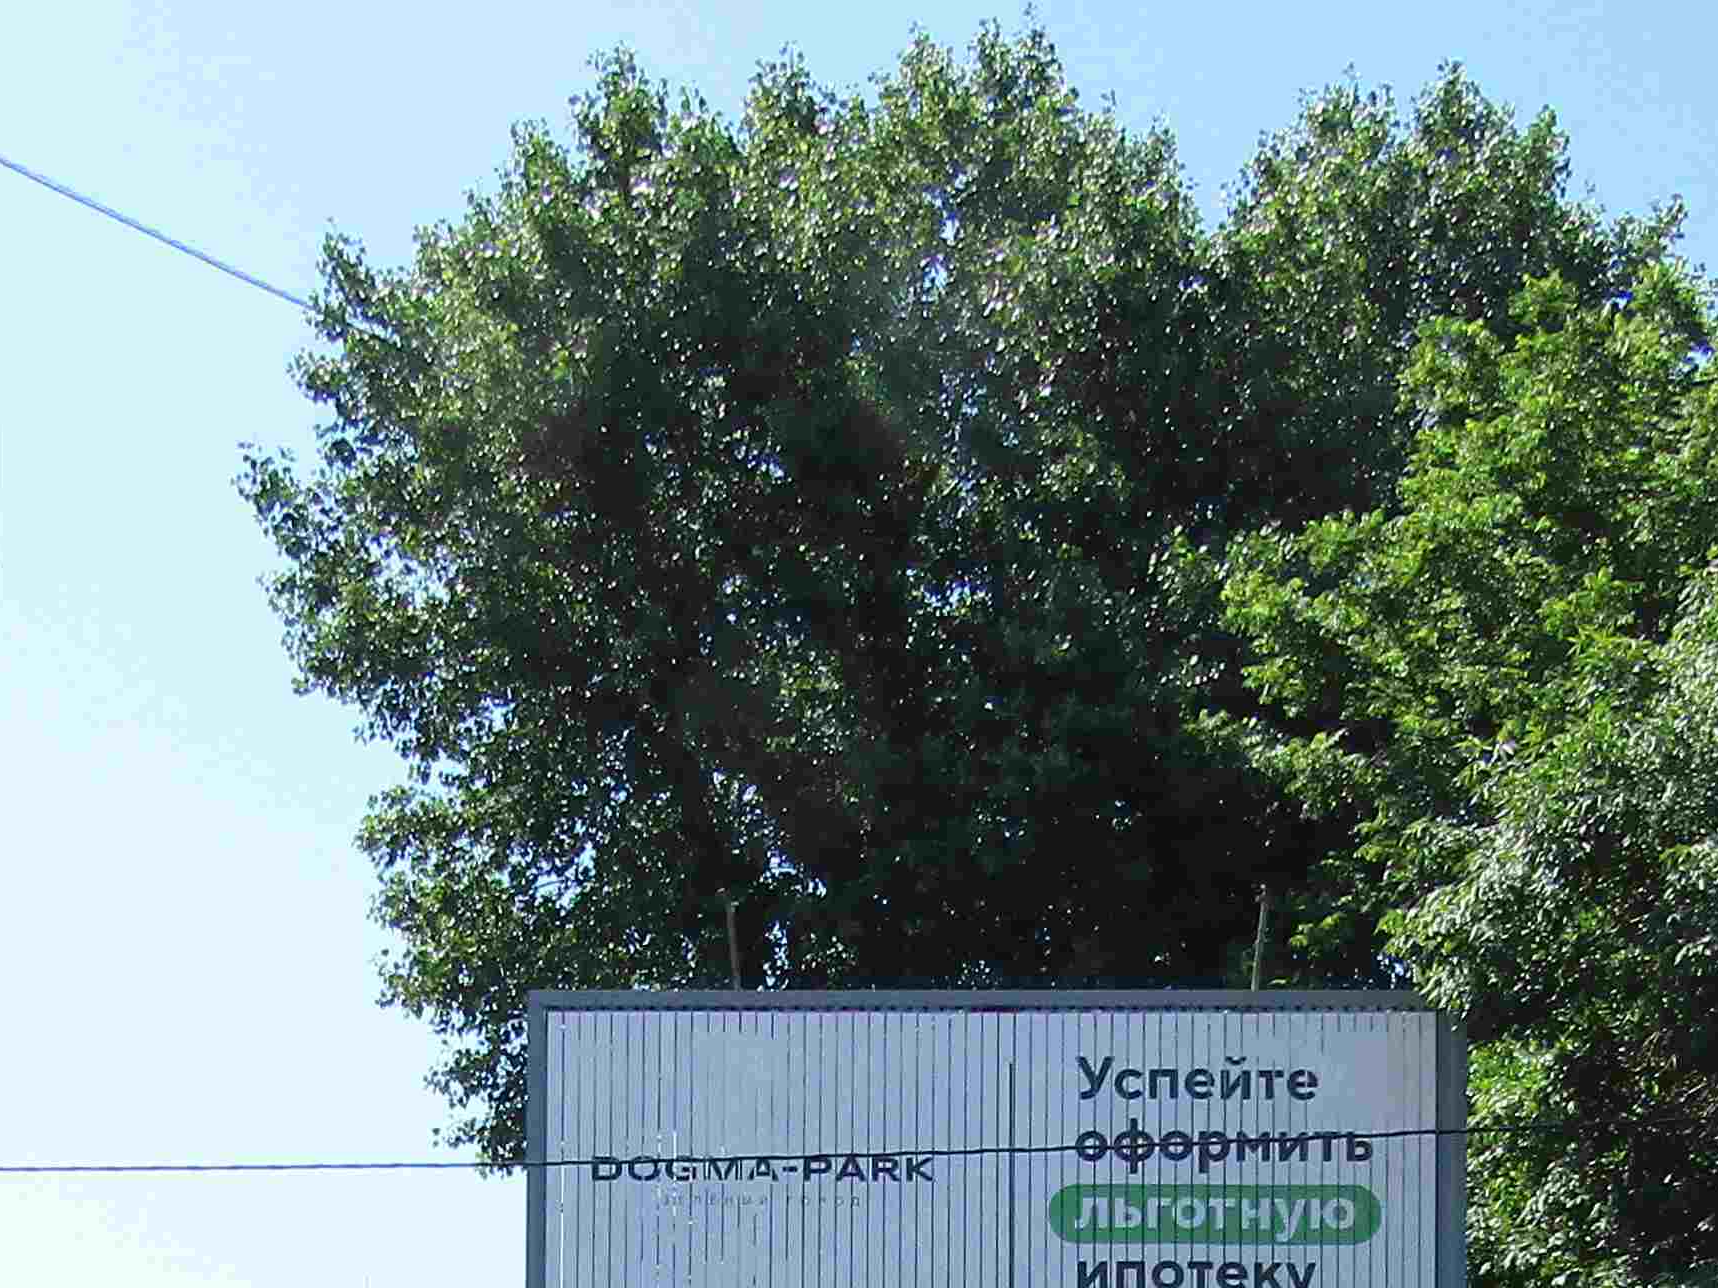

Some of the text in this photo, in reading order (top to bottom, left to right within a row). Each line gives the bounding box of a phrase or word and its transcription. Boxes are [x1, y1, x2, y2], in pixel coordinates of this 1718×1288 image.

[1077, 1056, 1320, 1102] Успейте
[591, 1155, 936, 1183] DOGMA-PARK
[1074, 1118, 1374, 1174] оформить
[1073, 1196, 1357, 1242] льготную
